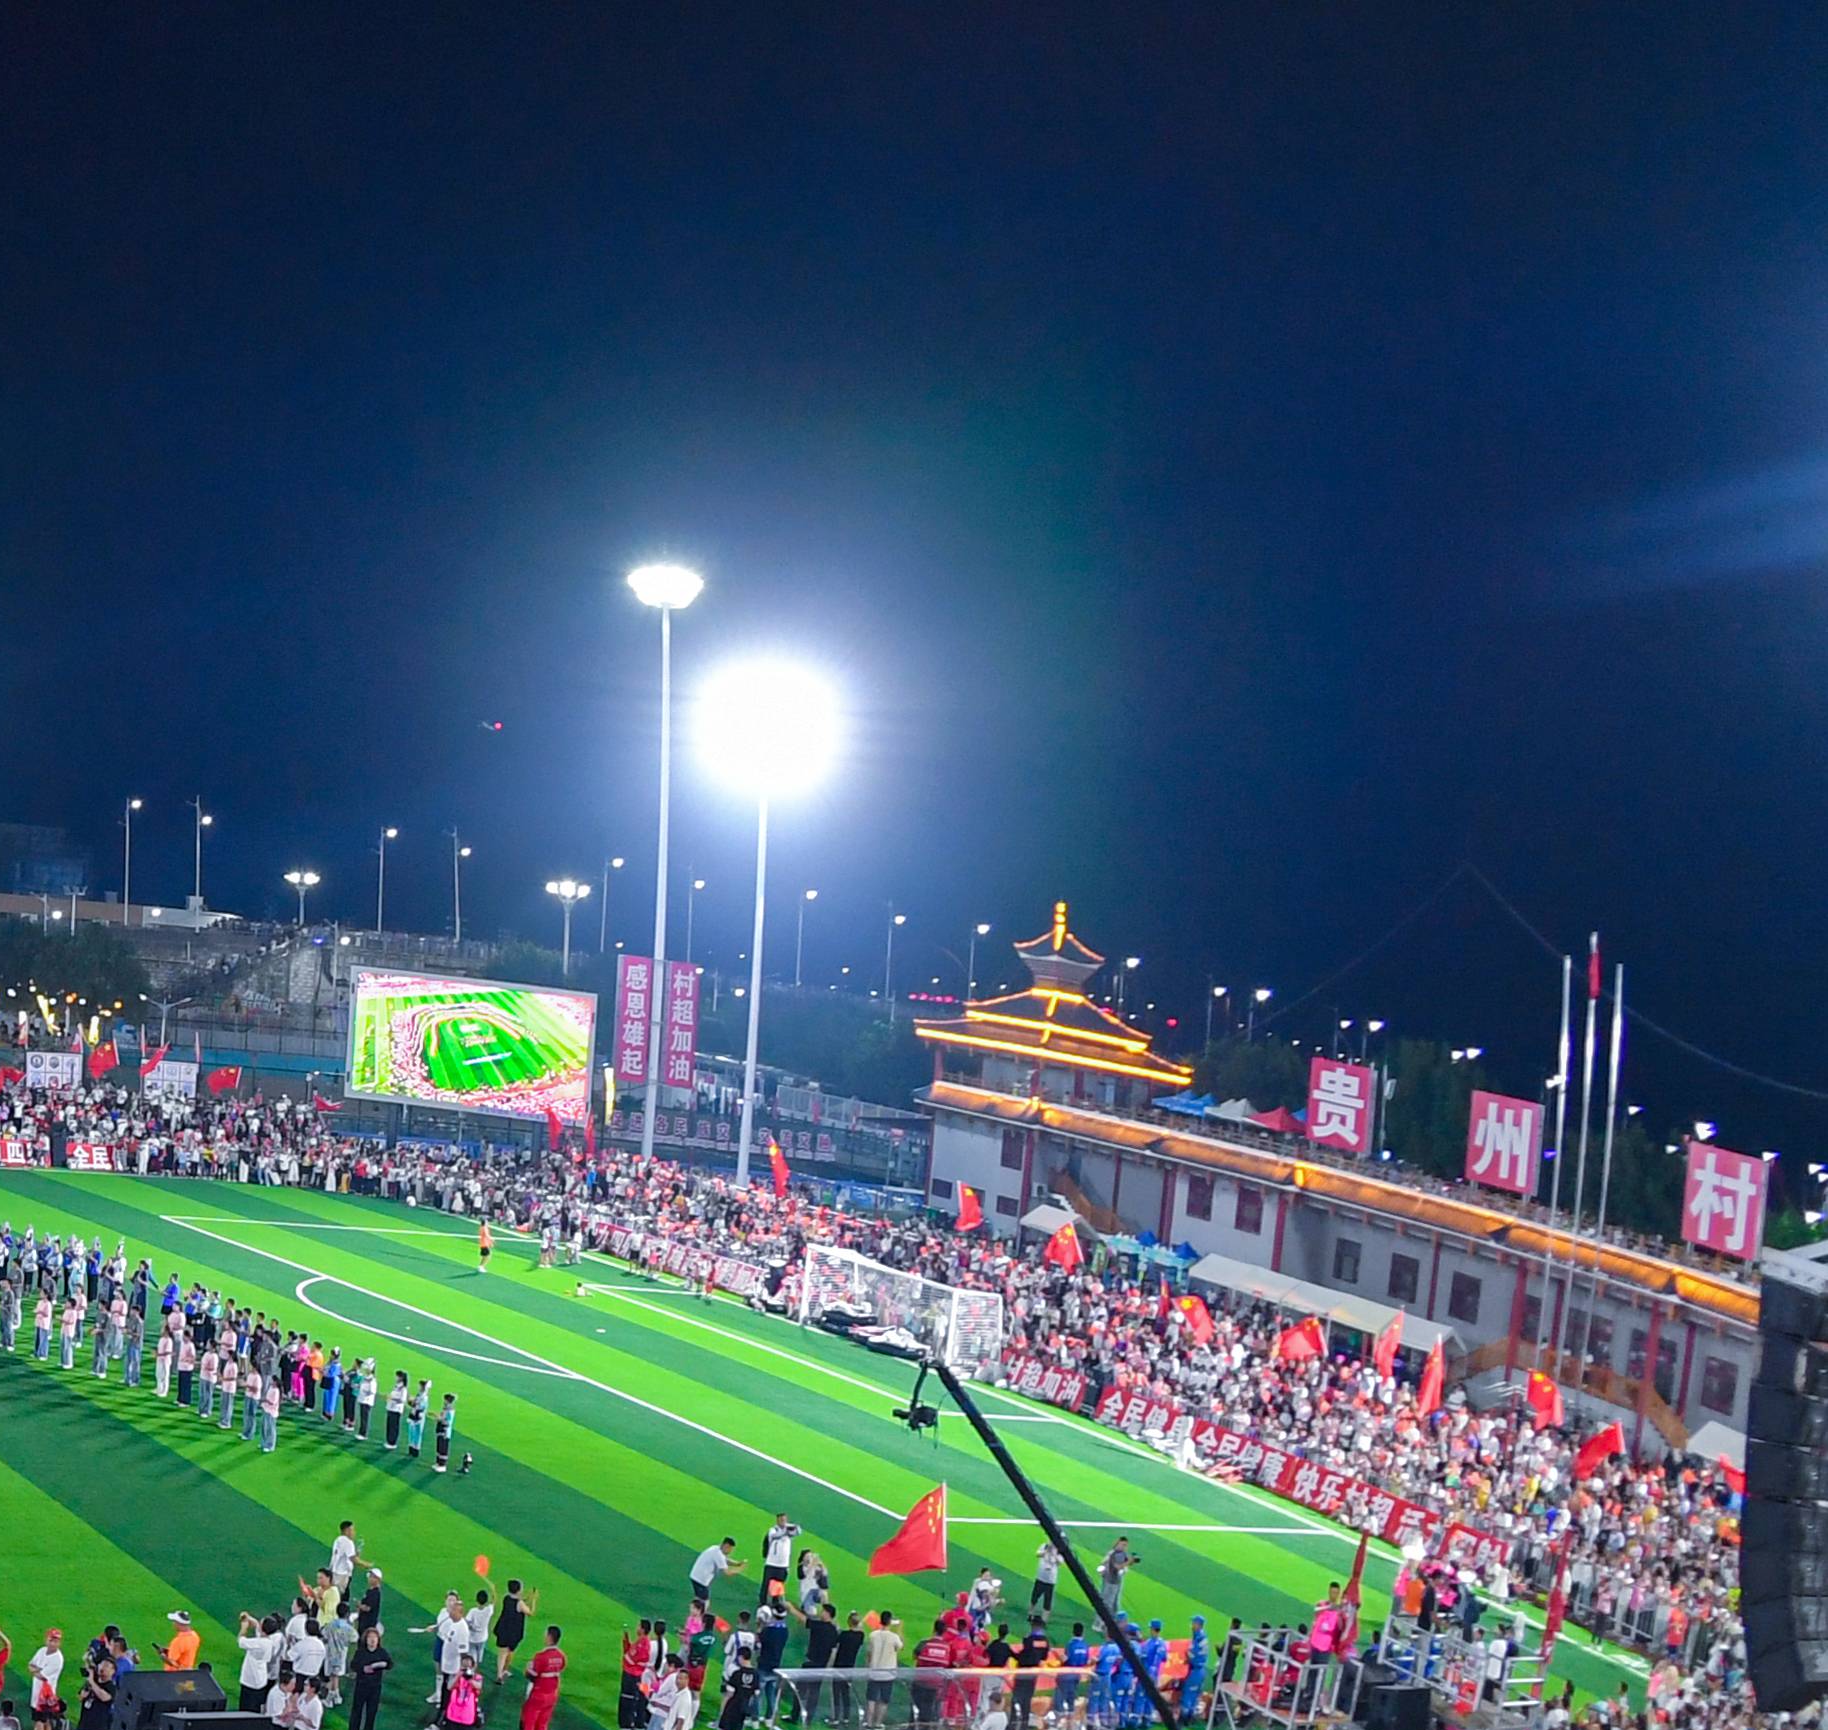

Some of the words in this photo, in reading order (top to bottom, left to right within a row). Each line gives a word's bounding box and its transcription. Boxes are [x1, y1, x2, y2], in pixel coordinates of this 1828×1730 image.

[621, 964, 647, 1076] 感恩雄起
[669, 970, 696, 1081] 村超加油
[1312, 1068, 1365, 1145] 贵
[1473, 1102, 1533, 1188] 州
[1690, 1153, 1756, 1251] 村
